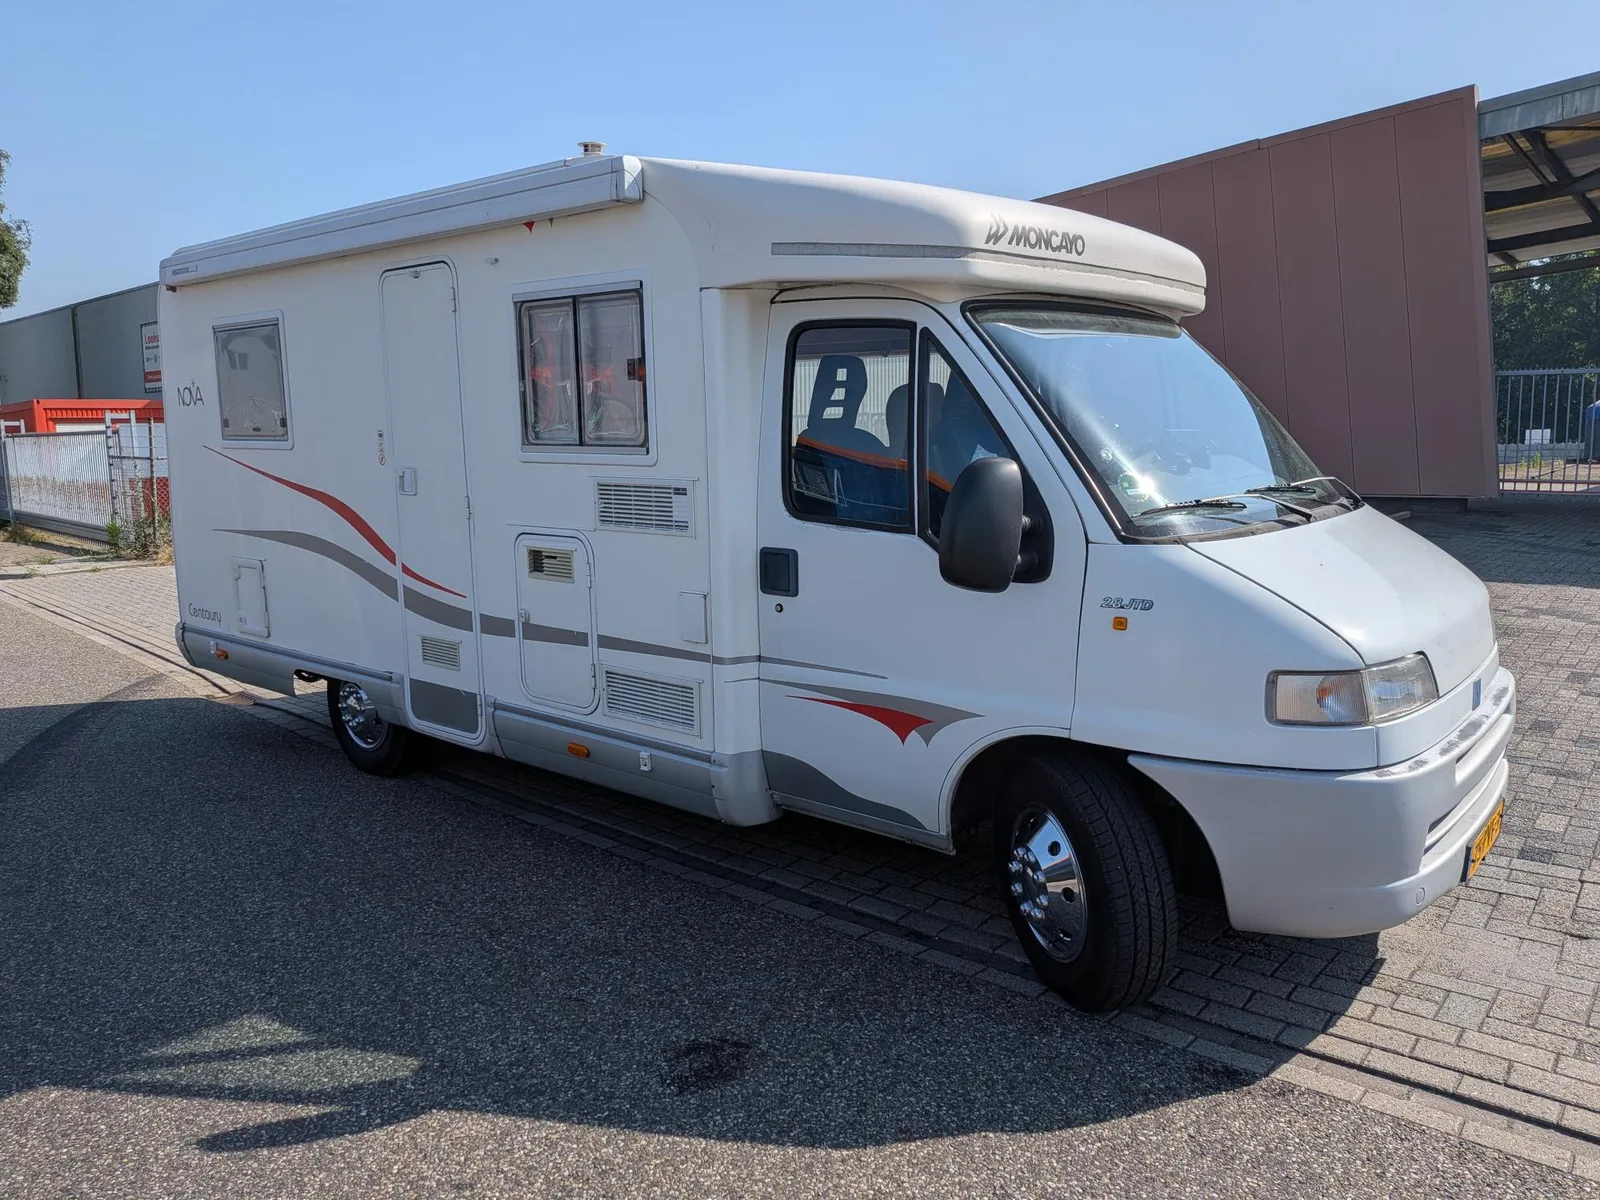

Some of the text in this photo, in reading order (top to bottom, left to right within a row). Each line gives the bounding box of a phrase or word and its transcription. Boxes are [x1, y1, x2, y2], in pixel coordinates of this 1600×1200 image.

[1008, 223, 1086, 257] MONCAYO
[177, 386, 205, 407] NOVA
[1122, 597, 1154, 611] JTD
